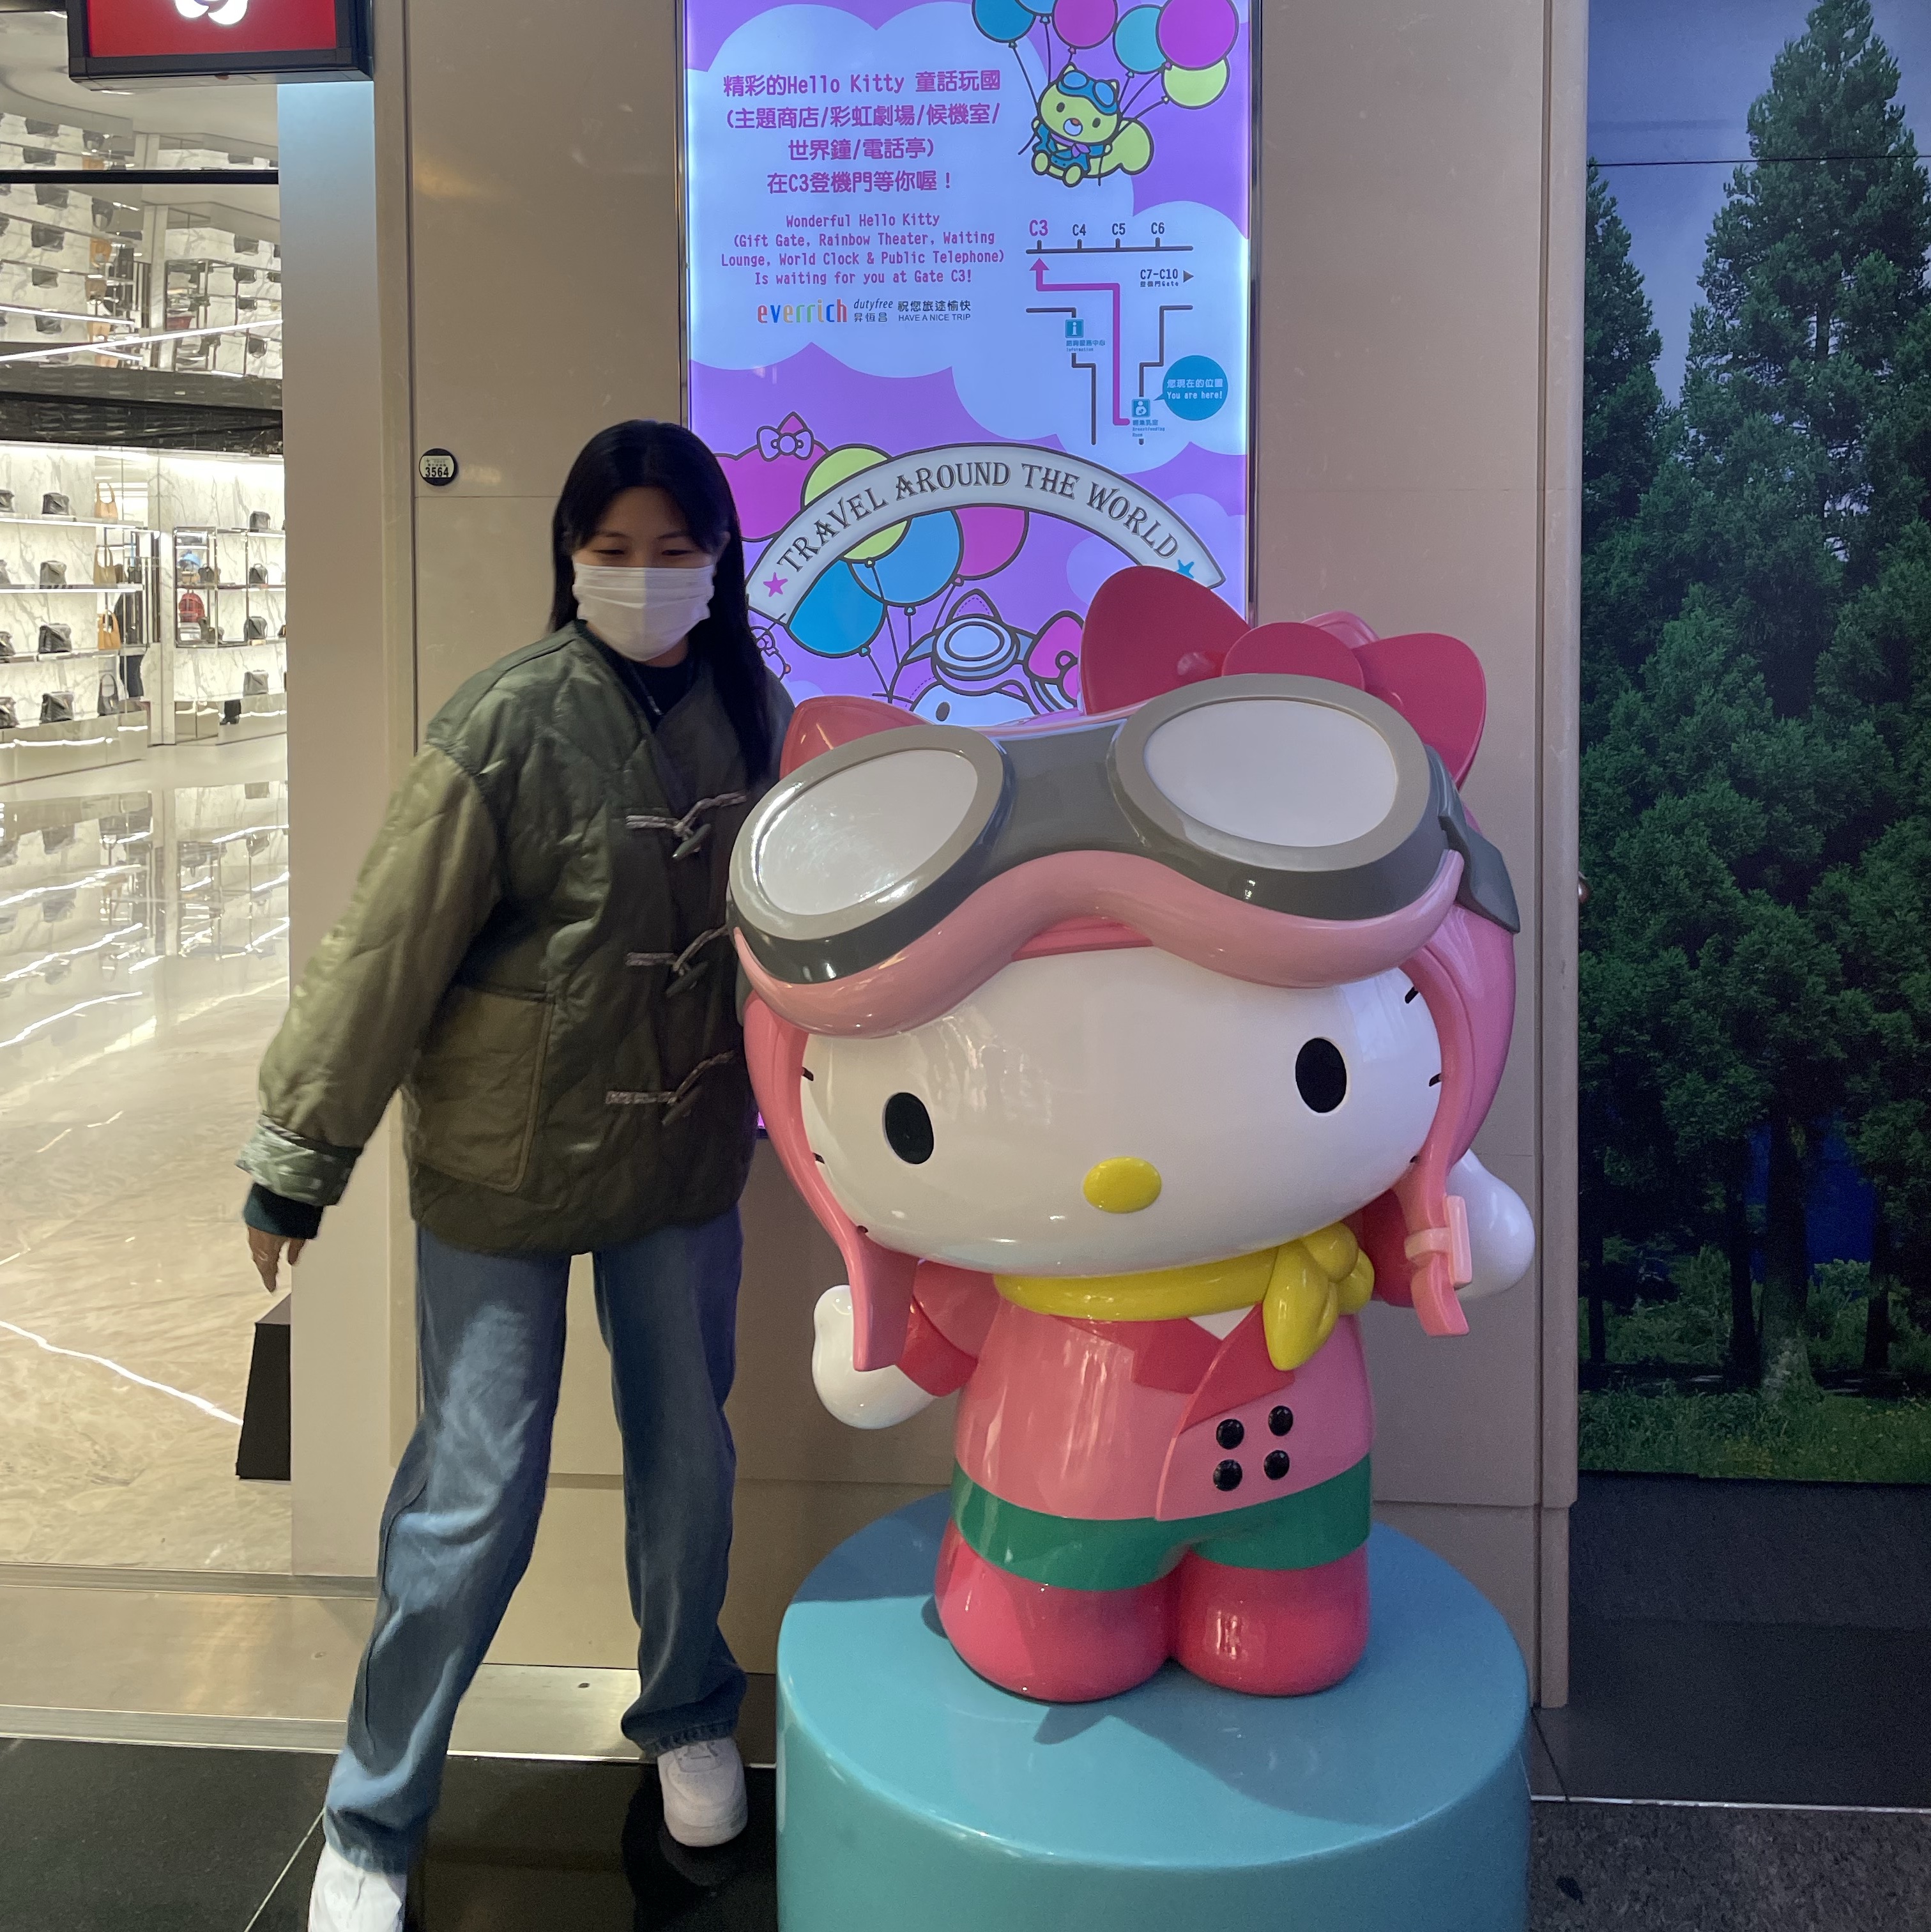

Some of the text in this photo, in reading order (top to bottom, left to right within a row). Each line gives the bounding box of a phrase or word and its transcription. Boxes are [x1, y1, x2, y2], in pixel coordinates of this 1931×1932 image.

[723, 70, 1000, 96] 精彩的Hello Kitty 童話玩國
[788, 137, 935, 160] 世界鐘/電話亭)
[786, 213, 940, 228] Wonderful Hello Kitty
[1030, 220, 1164, 236] C3 C4 C5 C6
[734, 231, 995, 248] (Gift Gate, Rainbow Theater, Waiting
[721, 249, 1004, 266] Lounge, World Clock & Public Telephone)
[755, 270, 972, 286] Is waiting for you at Gate C3!
[1140, 268, 1178, 279] C7-C10
[758, 298, 893, 324] everrich dutyfree
[897, 300, 971, 312] 祝您旅途愉快
[425, 467, 448, 478] 3564
[777, 461, 1179, 572] TRAVEL AROUND THE WORLD
